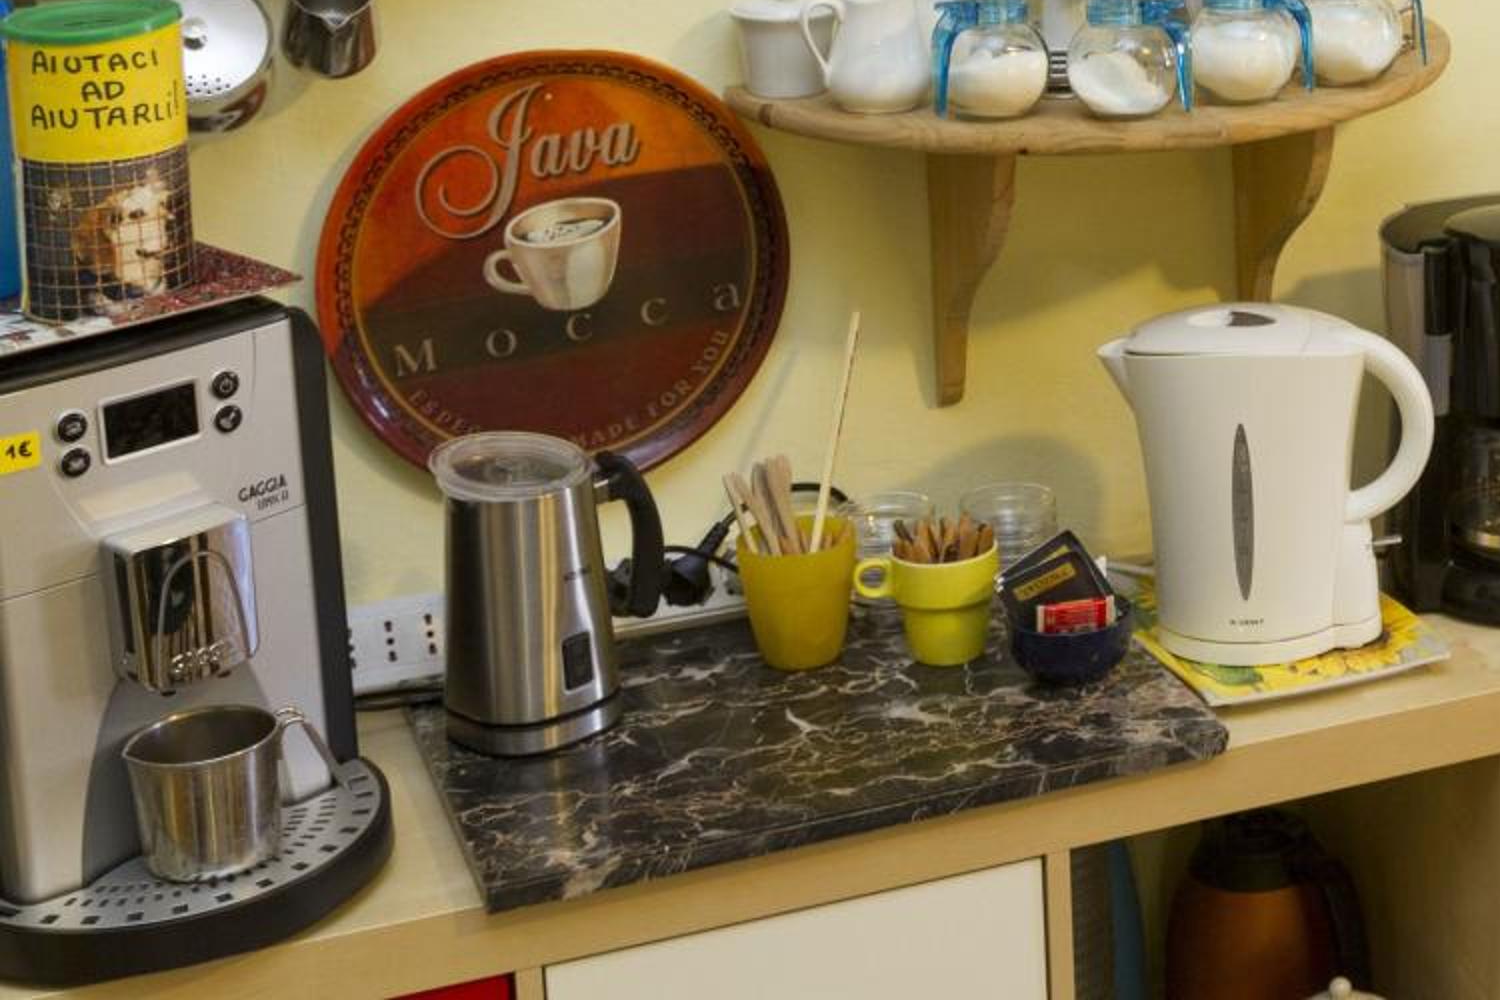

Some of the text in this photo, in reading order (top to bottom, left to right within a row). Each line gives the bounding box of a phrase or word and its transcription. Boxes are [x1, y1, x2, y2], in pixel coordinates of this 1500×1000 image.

[31, 50, 158, 75] AIUTACI
[80, 81, 125, 102] AD
[415, 81, 641, 240] Java
[5, 440, 33, 459] 1€
